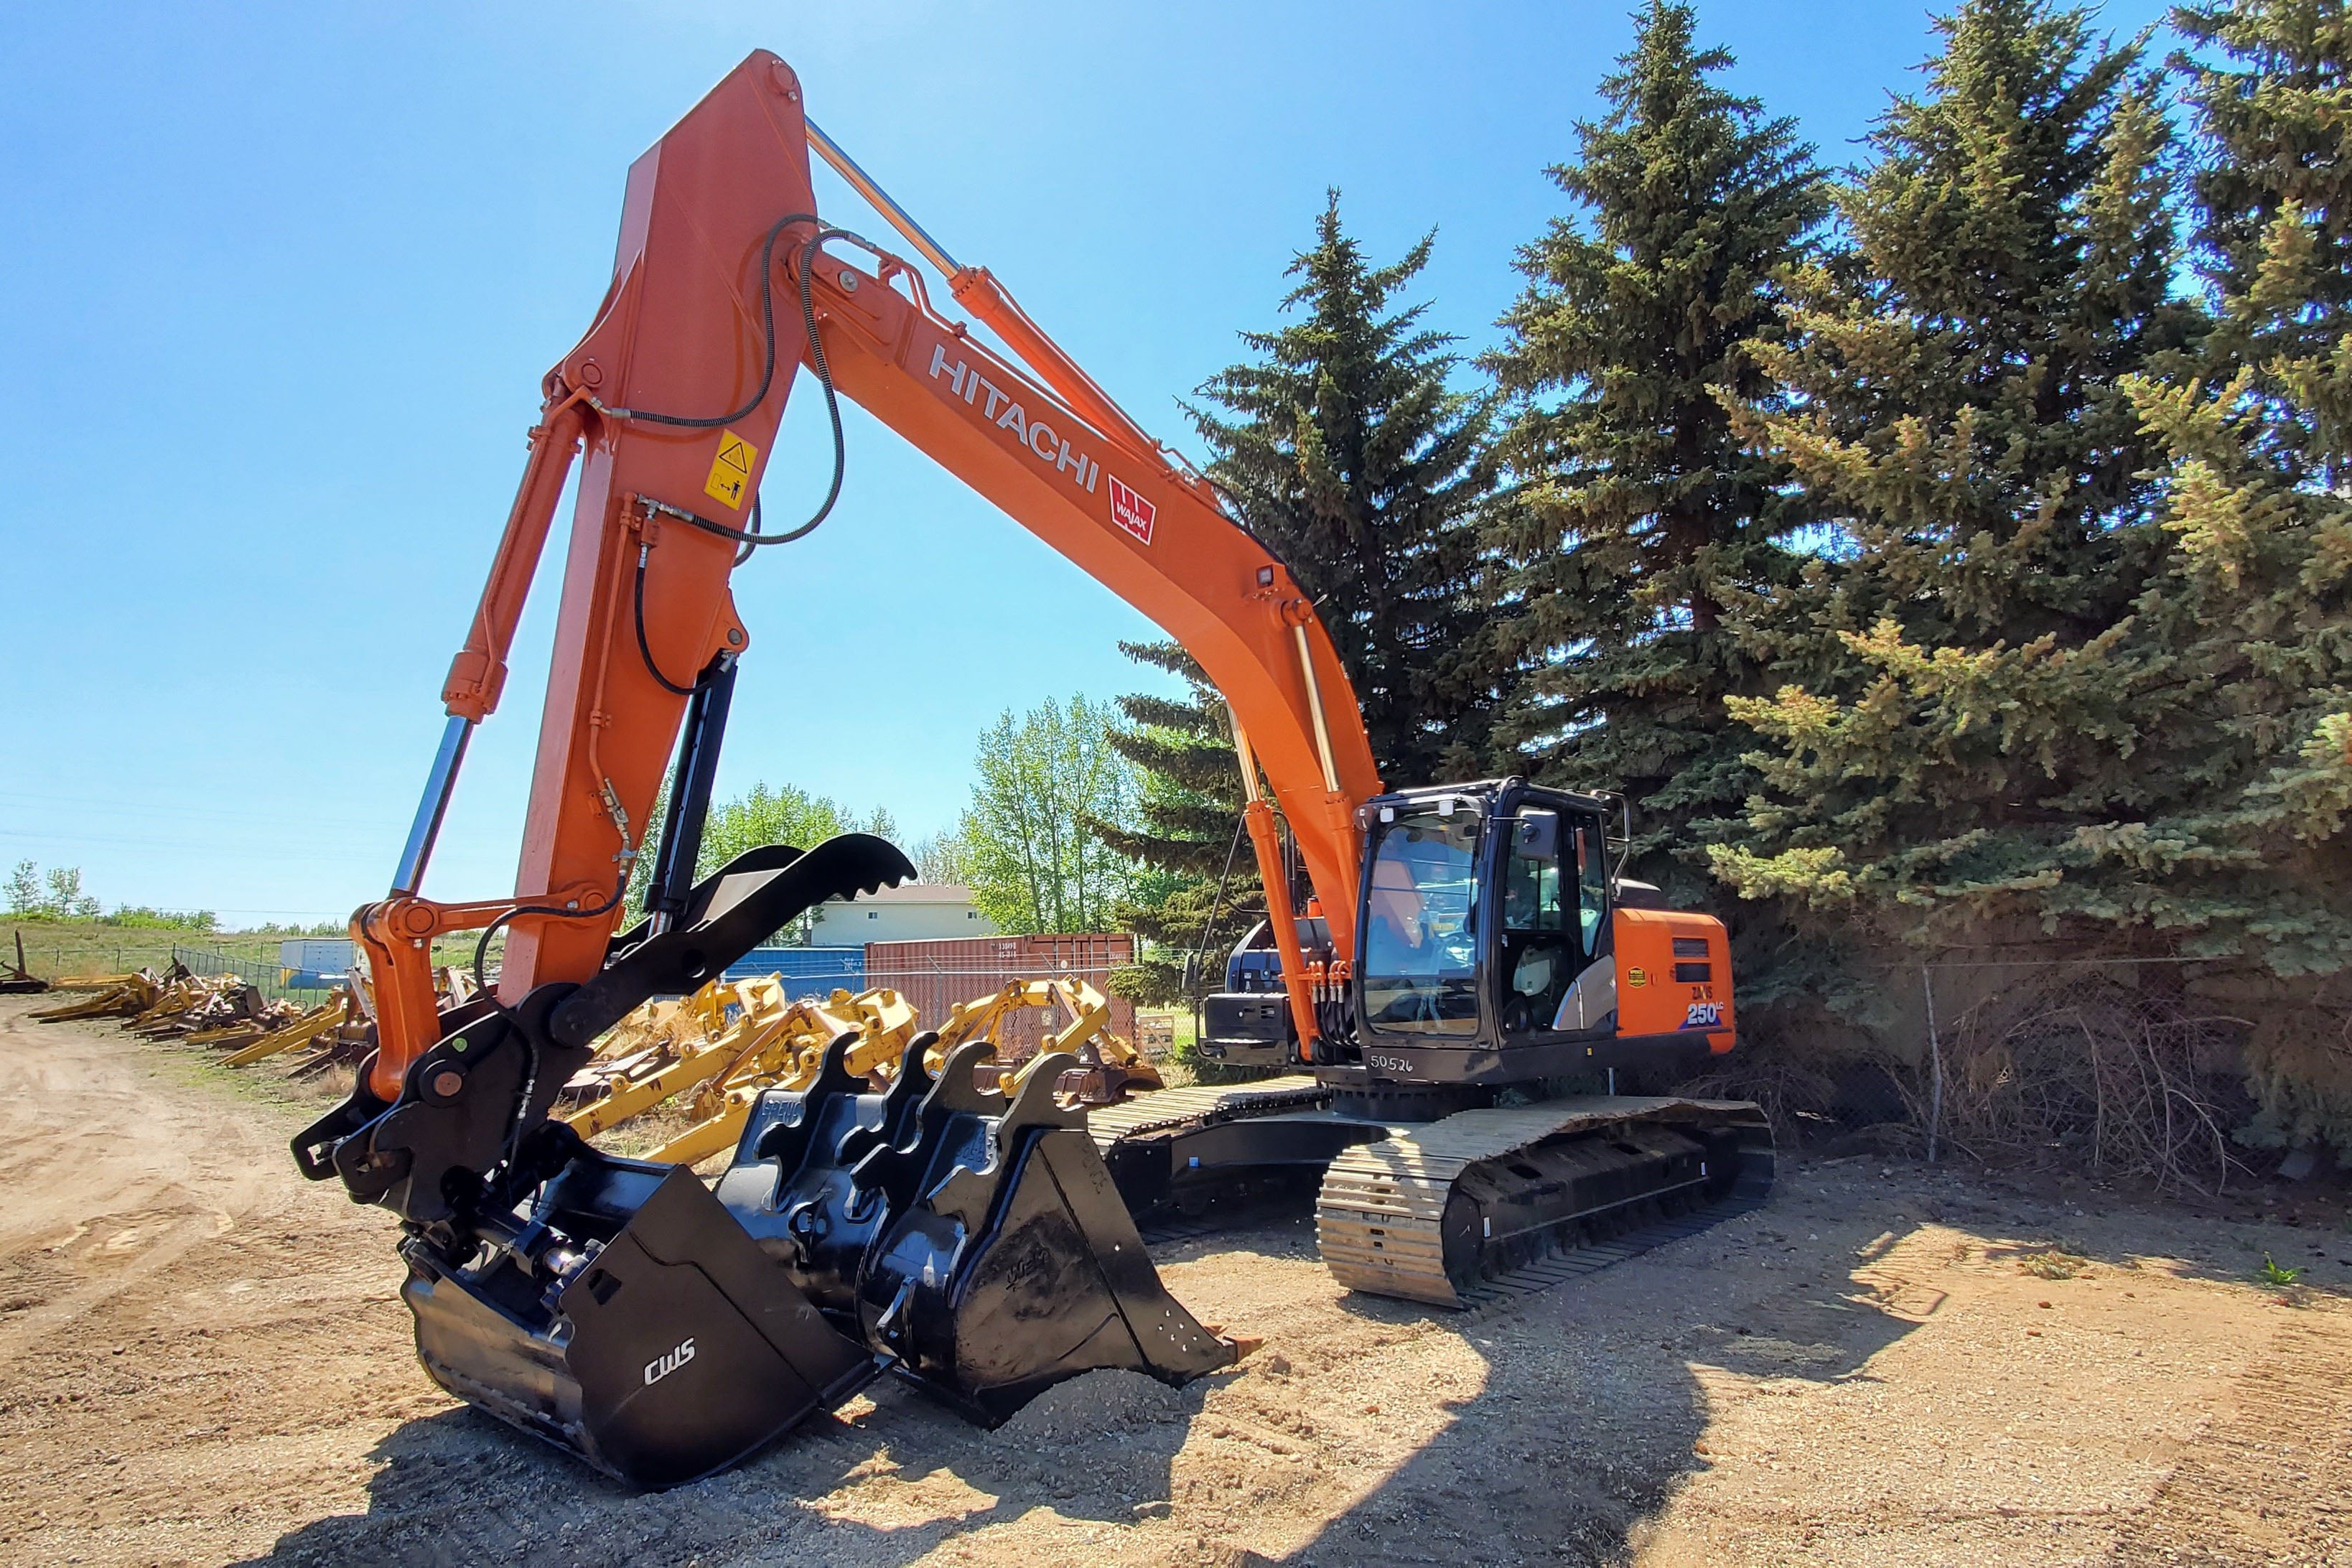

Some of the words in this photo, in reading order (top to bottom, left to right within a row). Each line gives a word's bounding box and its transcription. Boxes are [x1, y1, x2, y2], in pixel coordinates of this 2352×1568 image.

[929, 343, 1100, 494] HITACHI
[1116, 500, 1147, 531] WAJAX
[1687, 1002, 1717, 1025] 250
[1371, 1055, 1414, 1072] 50526
[762, 1099, 802, 1121] SPENC
[644, 1337, 696, 1386] CWS
